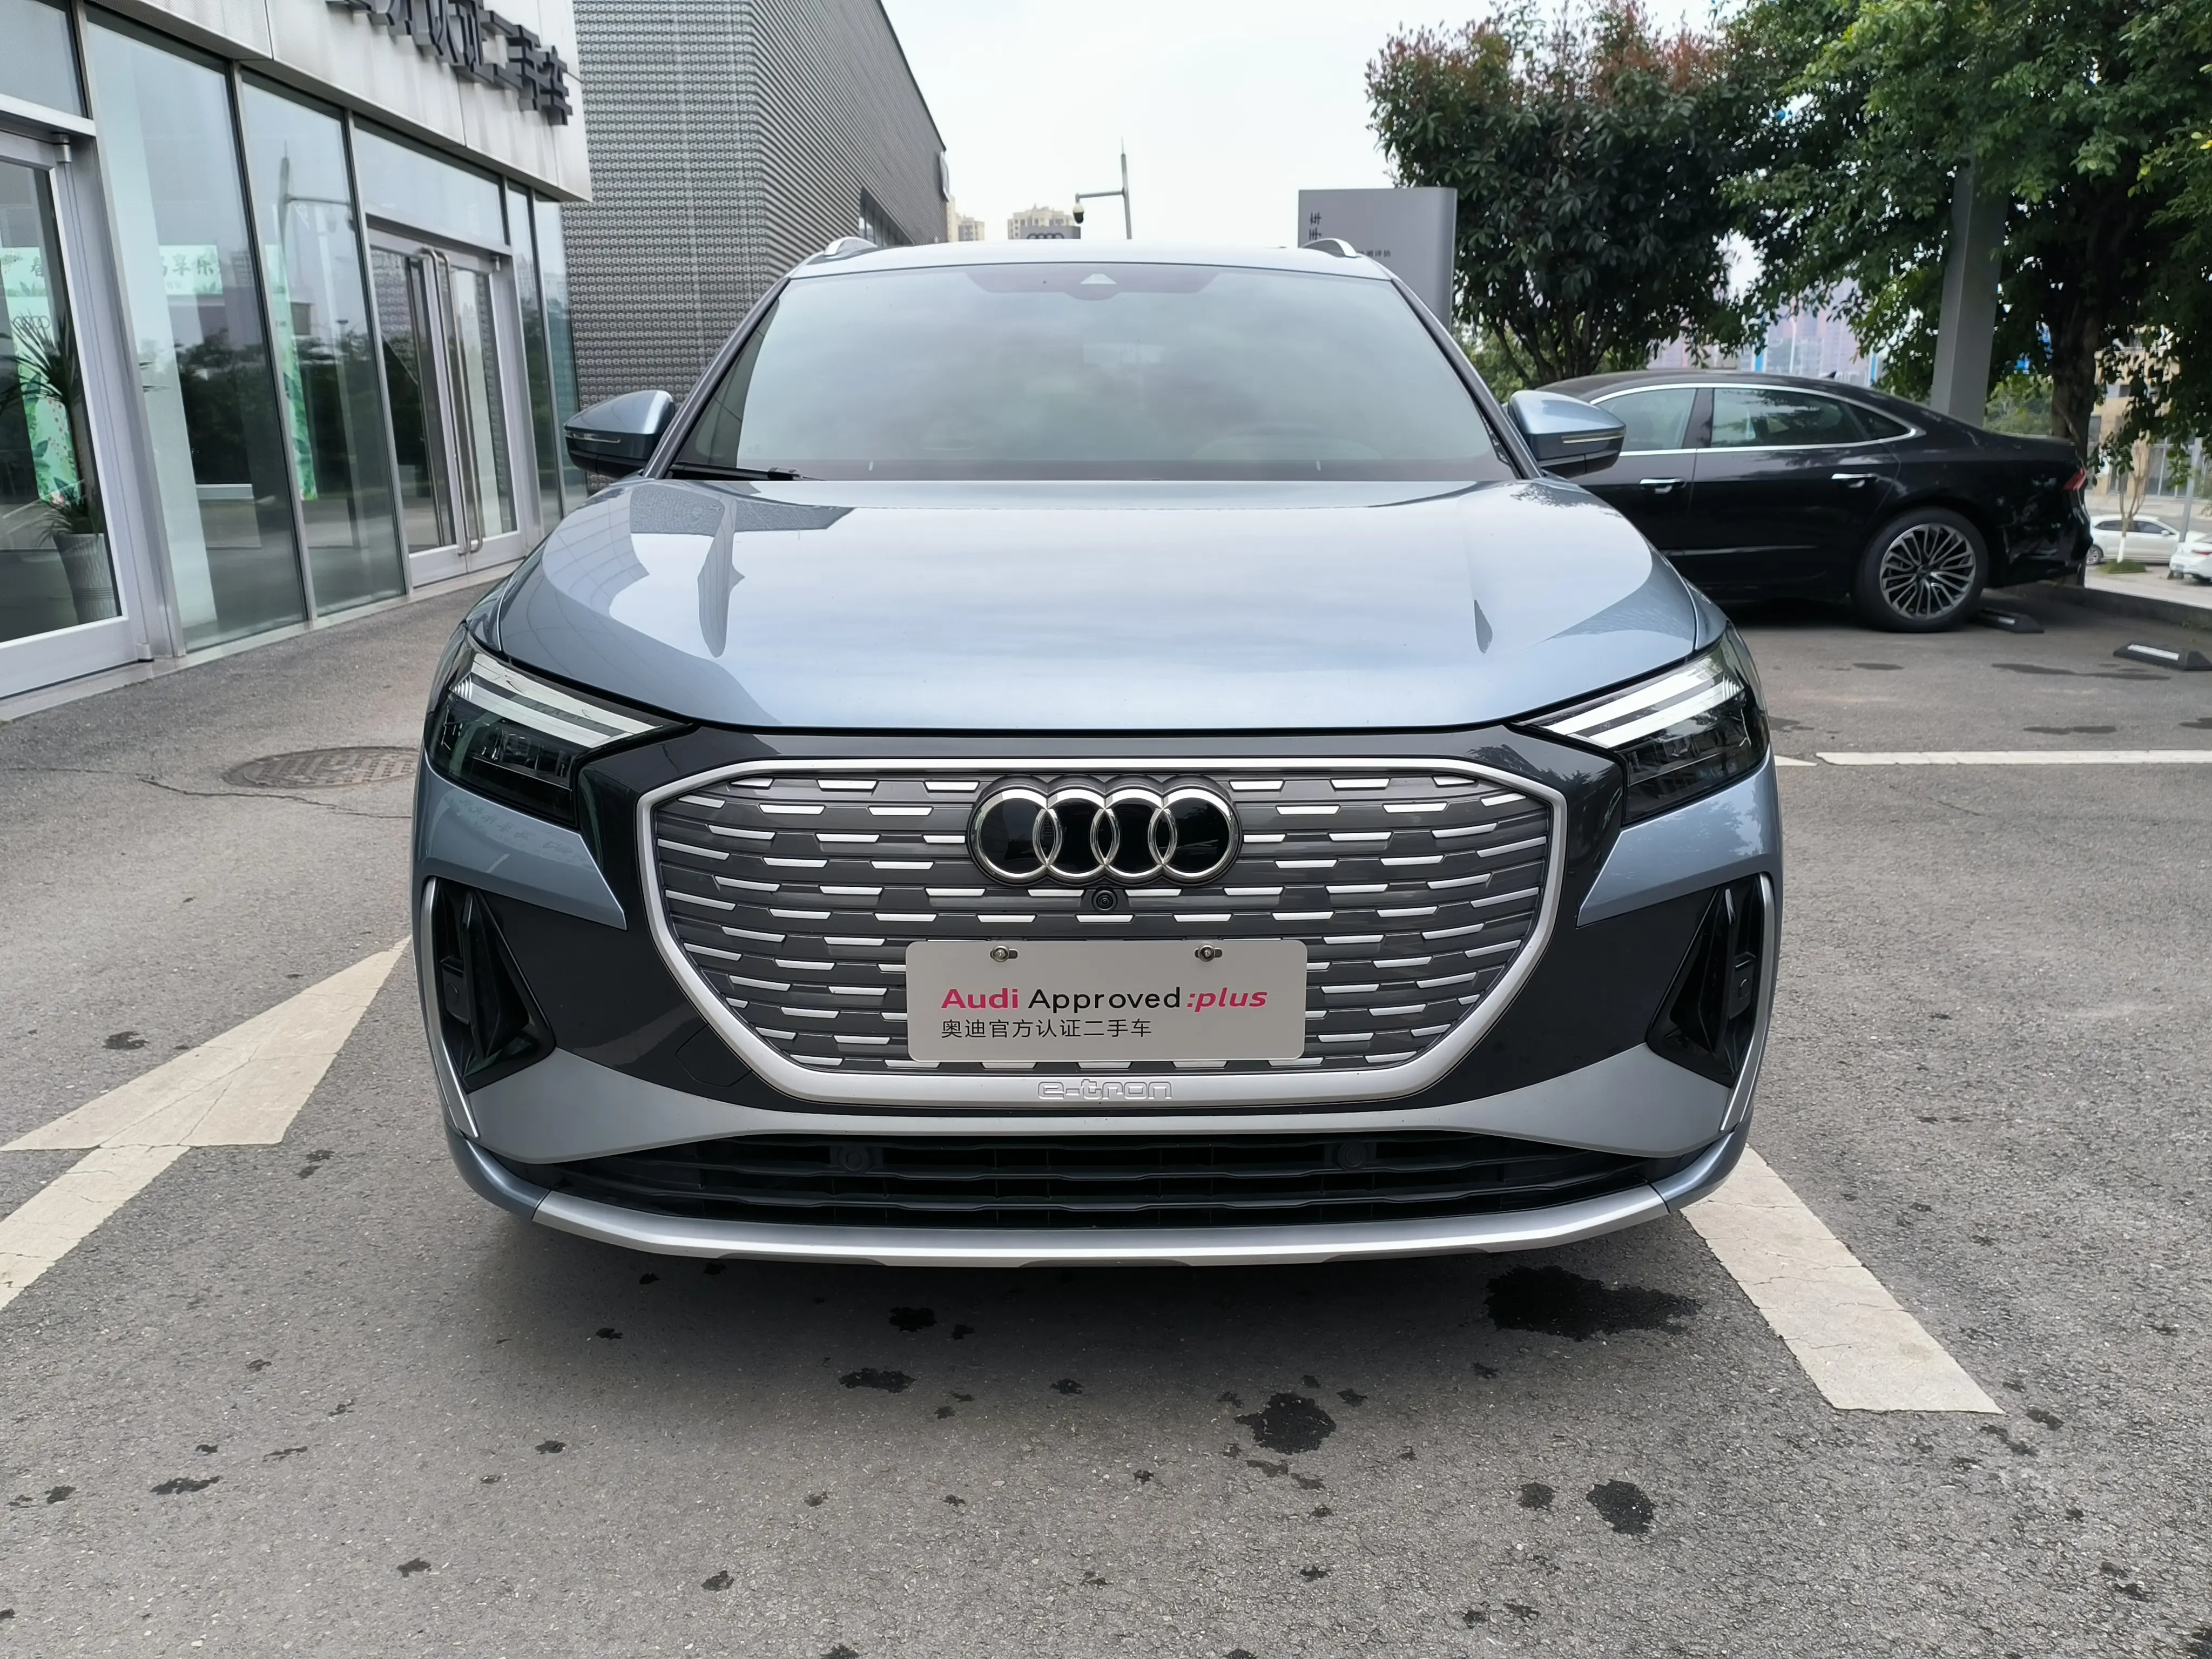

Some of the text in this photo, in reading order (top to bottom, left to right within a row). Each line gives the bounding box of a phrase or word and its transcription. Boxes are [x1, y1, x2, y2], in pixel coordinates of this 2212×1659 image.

[942, 987, 1019, 1009] Audi
[1028, 987, 1181, 1014] Approved
[942, 1019, 1152, 1039] 奥迪官方认证二手车
[1037, 1078, 1172, 1100] e-tron
